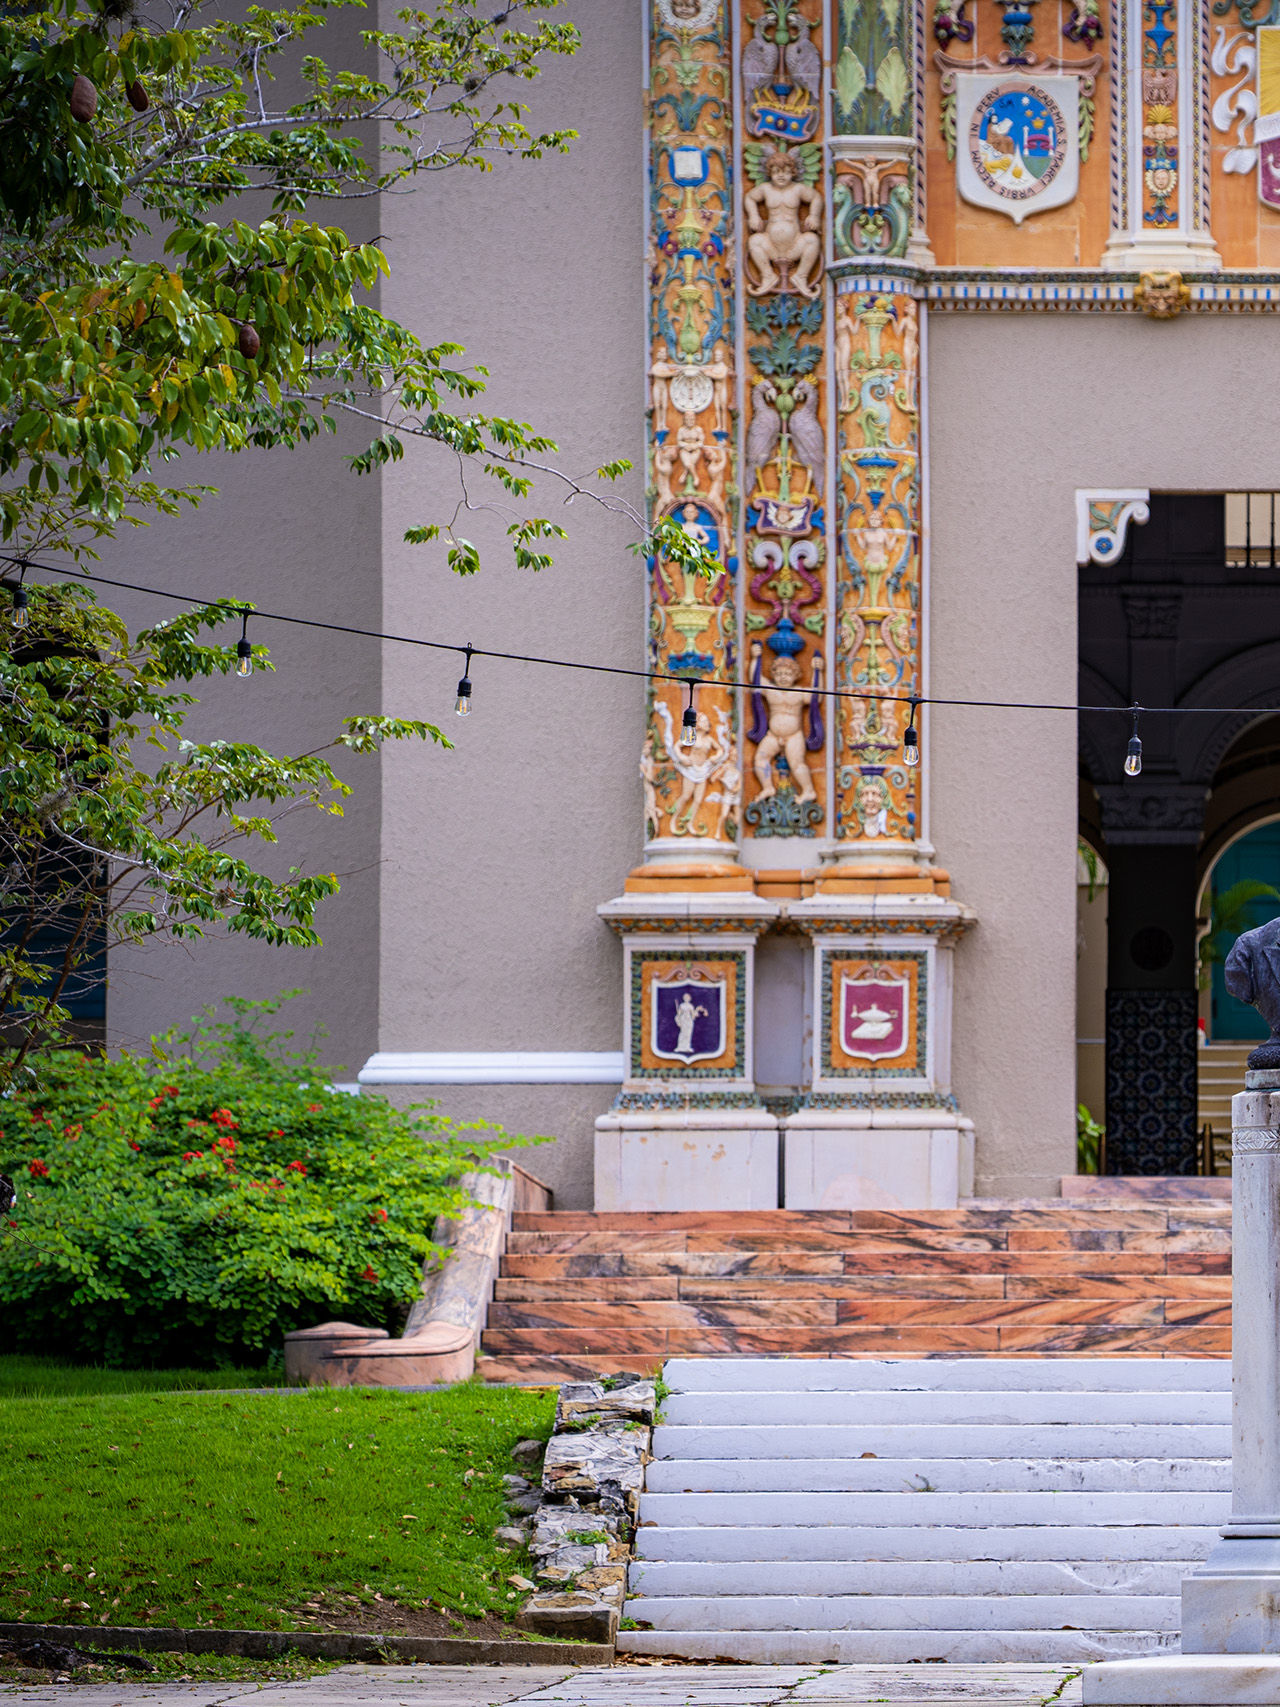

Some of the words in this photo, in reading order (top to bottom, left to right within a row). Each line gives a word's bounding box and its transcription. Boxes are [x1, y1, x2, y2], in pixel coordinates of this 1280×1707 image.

[976, 87, 1000, 113] PERV
[1026, 85, 1065, 134] ACADEMIA
[970, 123, 979, 137] IN
[1040, 151, 1064, 186] MARCI
[999, 186, 1035, 199] VRBIS
